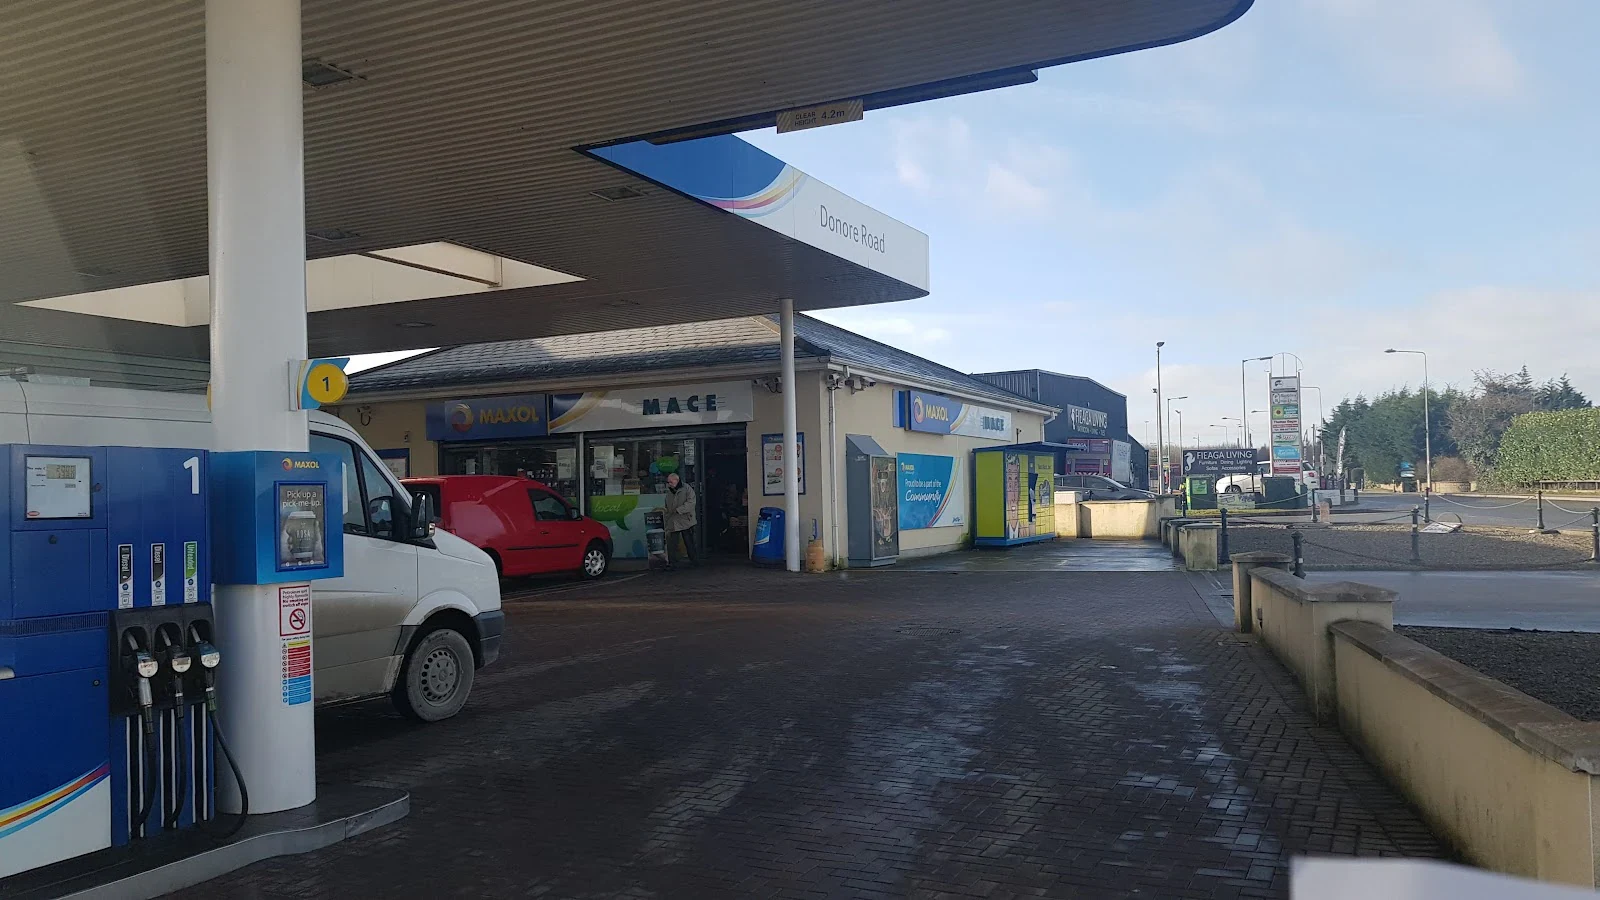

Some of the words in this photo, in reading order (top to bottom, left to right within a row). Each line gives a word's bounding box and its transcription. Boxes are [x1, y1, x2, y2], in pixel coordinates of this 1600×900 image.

[794, 117, 817, 127] HEIGHT
[795, 111, 816, 120] CLEAR
[821, 109, 845, 119] 4.2m
[820, 204, 859, 243] Donore
[861, 224, 885, 254] Road
[322, 376, 329, 391] 1
[642, 394, 717, 415] MACE
[480, 405, 540, 424] MAXOL
[925, 404, 949, 422] MAXOL
[982, 415, 1005, 431] MACE
[1226, 450, 1253, 459] LIVING
[294, 461, 320, 469] MAXOL
[183, 456, 200, 494] 1
[286, 490, 301, 499] Pick
[303, 491, 311, 500] up
[905, 490, 942, 508] Community
[282, 499, 321, 508] pick-me-up.
[594, 500, 622, 512] local
[121, 554, 130, 572] Diesel
[154, 546, 162, 564] Diesel
[187, 544, 195, 570] Unleaded
